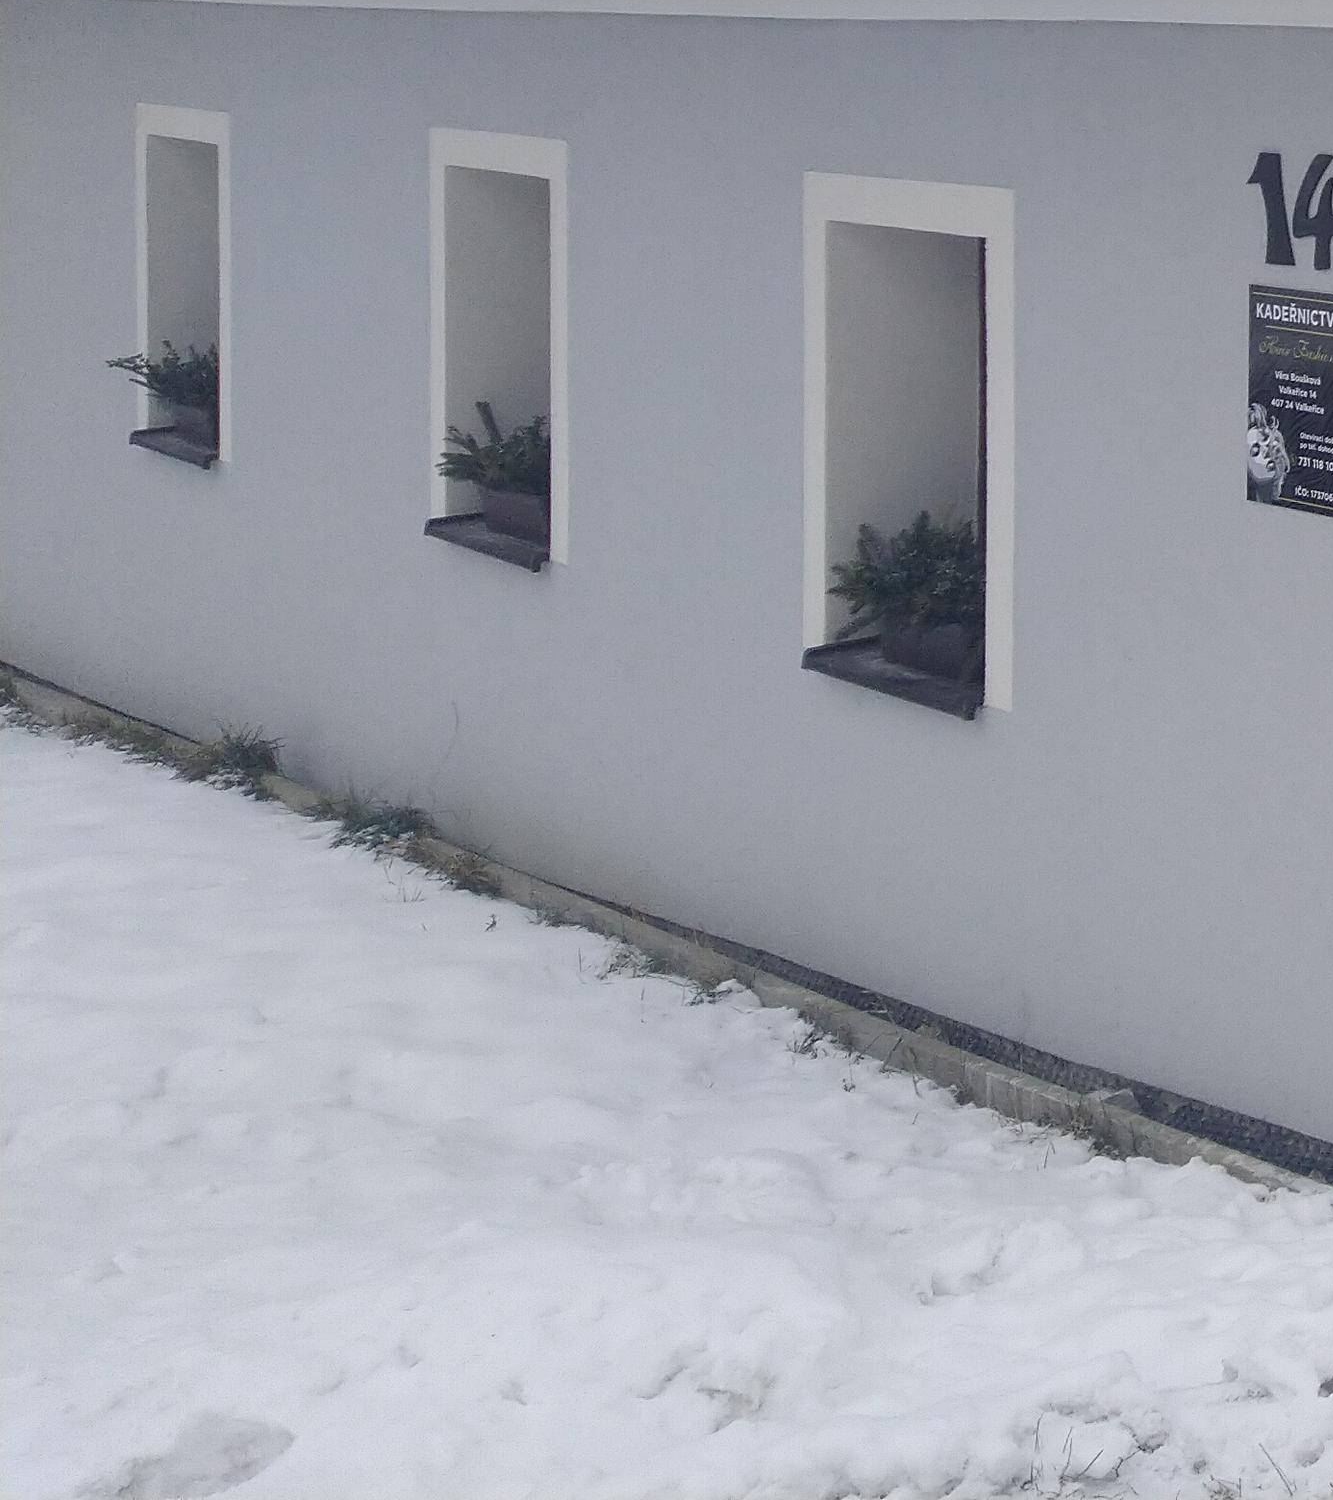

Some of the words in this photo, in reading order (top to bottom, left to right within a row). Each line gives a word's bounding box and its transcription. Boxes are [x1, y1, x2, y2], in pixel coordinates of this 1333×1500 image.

[1271, 398, 1284, 408] 407
[1285, 400, 1294, 409] 24
[1298, 456, 1311, 468] 731
[1312, 458, 1324, 470] 118
